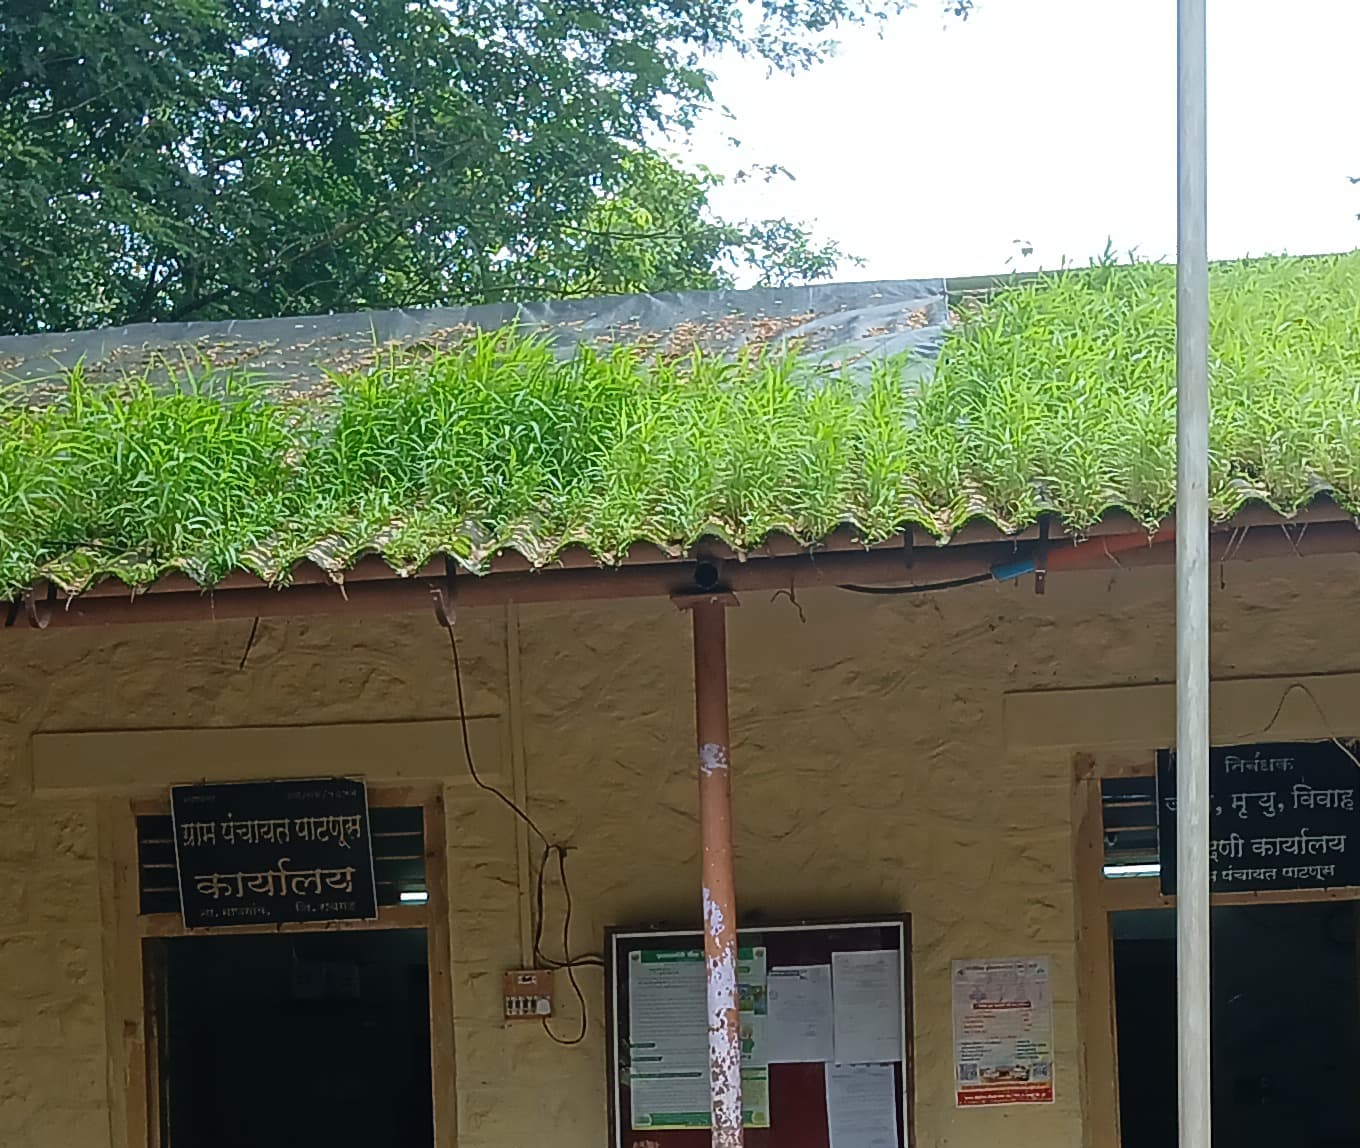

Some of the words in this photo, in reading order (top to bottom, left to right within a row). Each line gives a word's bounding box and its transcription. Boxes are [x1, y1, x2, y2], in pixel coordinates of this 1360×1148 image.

[1224, 751, 1296, 774] निबंधक
[1292, 783, 1355, 812] विवाह
[181, 820, 216, 847] ग्राम
[221, 811, 290, 845] पंचायत
[1251, 828, 1347, 857] कार्यालय
[193, 857, 357, 899] कार्यालय
[1221, 864, 1278, 882] पंचायत
